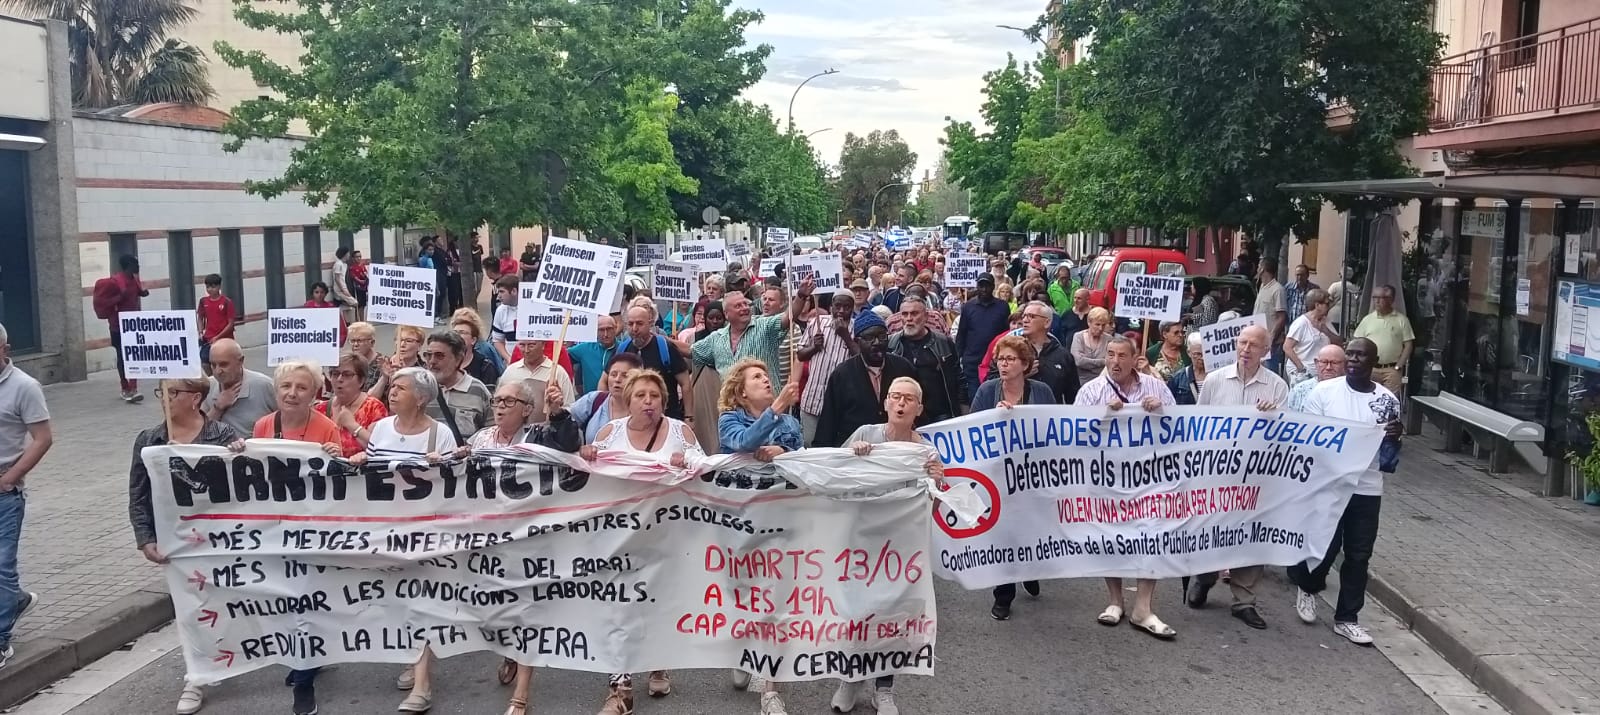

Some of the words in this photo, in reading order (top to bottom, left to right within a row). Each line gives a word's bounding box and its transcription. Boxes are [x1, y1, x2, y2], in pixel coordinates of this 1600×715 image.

[545, 253, 552, 262] la
[549, 243, 596, 261] defensem
[682, 245, 704, 253] Visites
[682, 249, 725, 261] presencials!
[373, 266, 384, 275] No
[386, 269, 404, 278] som
[957, 259, 984, 267] SANITAT
[543, 263, 596, 287] SANITAT
[656, 275, 686, 288] SANITAT
[951, 270, 978, 281] NEGOCI!
[1126, 278, 1134, 287] la
[1136, 276, 1181, 291] SANITAT
[380, 277, 433, 292] números,
[392, 289, 411, 297] som
[537, 278, 604, 309] PÚBLICA!
[656, 282, 690, 299] PÚBLICA!
[1131, 287, 1141, 295] és
[372, 294, 433, 316] persones!
[1124, 295, 1169, 312] NEGOCI!
[122, 315, 185, 333] potenciem
[271, 317, 306, 329] Visites
[136, 332, 145, 344] la
[271, 328, 337, 347] presencials!
[124, 337, 188, 365] PRIMÀRIA!
[968, 417, 1101, 461] RETALLADES
[1106, 418, 1123, 448] A
[1127, 415, 1154, 448] LA
[1159, 415, 1250, 445] SANITAT
[1248, 412, 1349, 453] PÚBLICA
[1004, 452, 1085, 495] Defensem
[1090, 450, 1116, 488] els
[1121, 450, 1180, 489] nostres
[1183, 441, 1243, 479] serveis
[1243, 443, 1314, 483] públics
[1057, 497, 1092, 524] VOLEM
[1094, 499, 1119, 524] UNA
[1120, 493, 1163, 522] SANITAT
[1165, 491, 1193, 520] DIGNA
[1191, 488, 1207, 515] PER
[1209, 487, 1217, 513] A
[1218, 486, 1261, 513] TOTHOM
[209, 523, 262, 551] MÉS
[282, 529, 378, 554] METGES,
[941, 544, 1015, 572] Coordinadora
[1017, 550, 1033, 562] en
[1036, 535, 1082, 561] defensa
[1084, 535, 1100, 555] de
[1101, 534, 1114, 555] la
[1116, 530, 1161, 556] Sanitat
[1163, 528, 1196, 555] Pública
[1198, 528, 1210, 550] de
[1212, 522, 1248, 549] Mataró-
[1249, 521, 1304, 550] Maresme
[212, 557, 266, 587] MÉS
[522, 557, 561, 579] DEL
[834, 539, 922, 587] 13/06
[343, 579, 384, 606] LES
[532, 580, 656, 603] LABORALS.
[704, 583, 722, 607] A
[734, 586, 775, 614] LES
[786, 586, 838, 616] 19h
[676, 612, 727, 638] CAP
[731, 613, 875, 646] GATASSA/CAMÍ
[877, 621, 899, 639] DEL
[240, 631, 327, 660] REDUÏR
[341, 628, 371, 652] LA
[739, 648, 783, 677] AVV
[794, 643, 932, 679] CERDANYOLA
